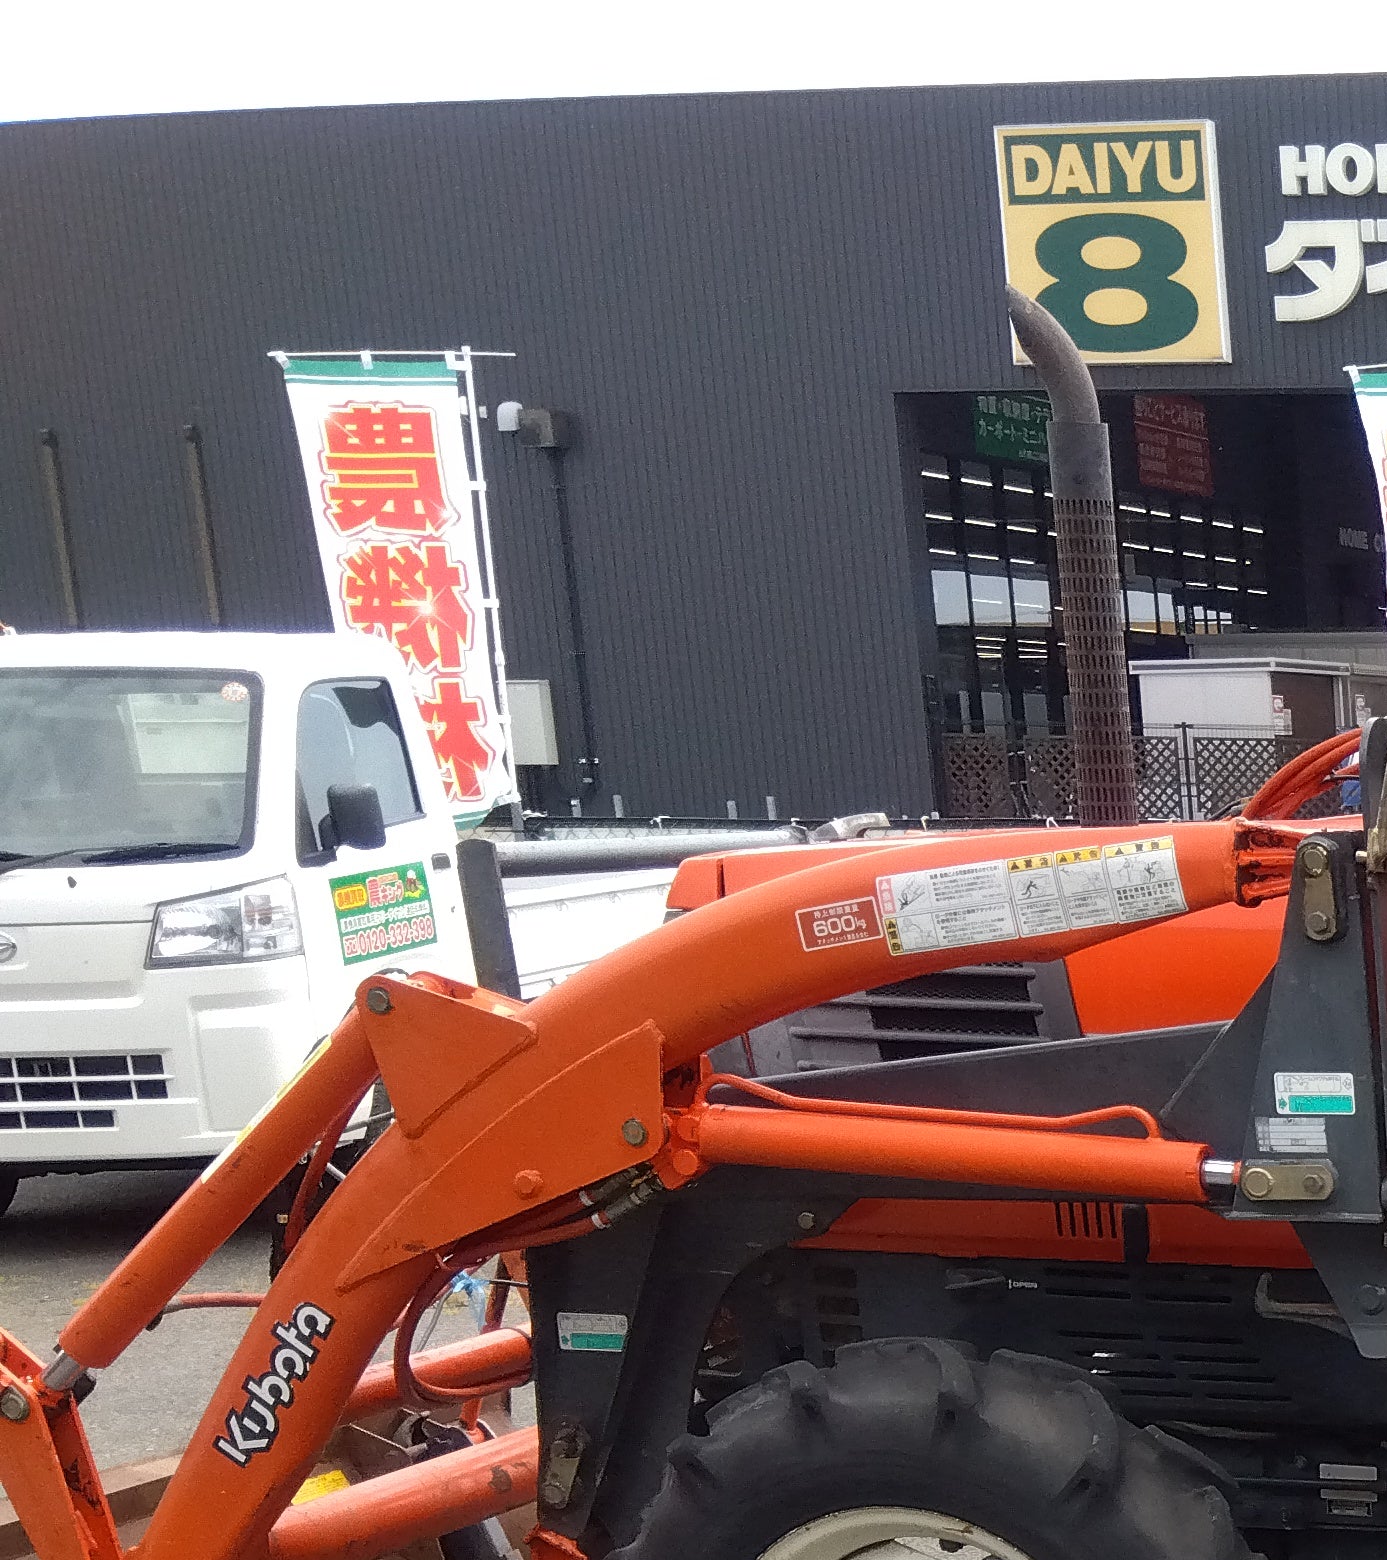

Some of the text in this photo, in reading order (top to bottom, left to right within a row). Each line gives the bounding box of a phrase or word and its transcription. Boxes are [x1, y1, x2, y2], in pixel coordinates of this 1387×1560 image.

[1011, 139, 1197, 196] DAIYU
[1034, 213, 1199, 353] 8
[357, 916, 434, 955] 0120-332-398
[214, 1303, 335, 1467] Kubota
